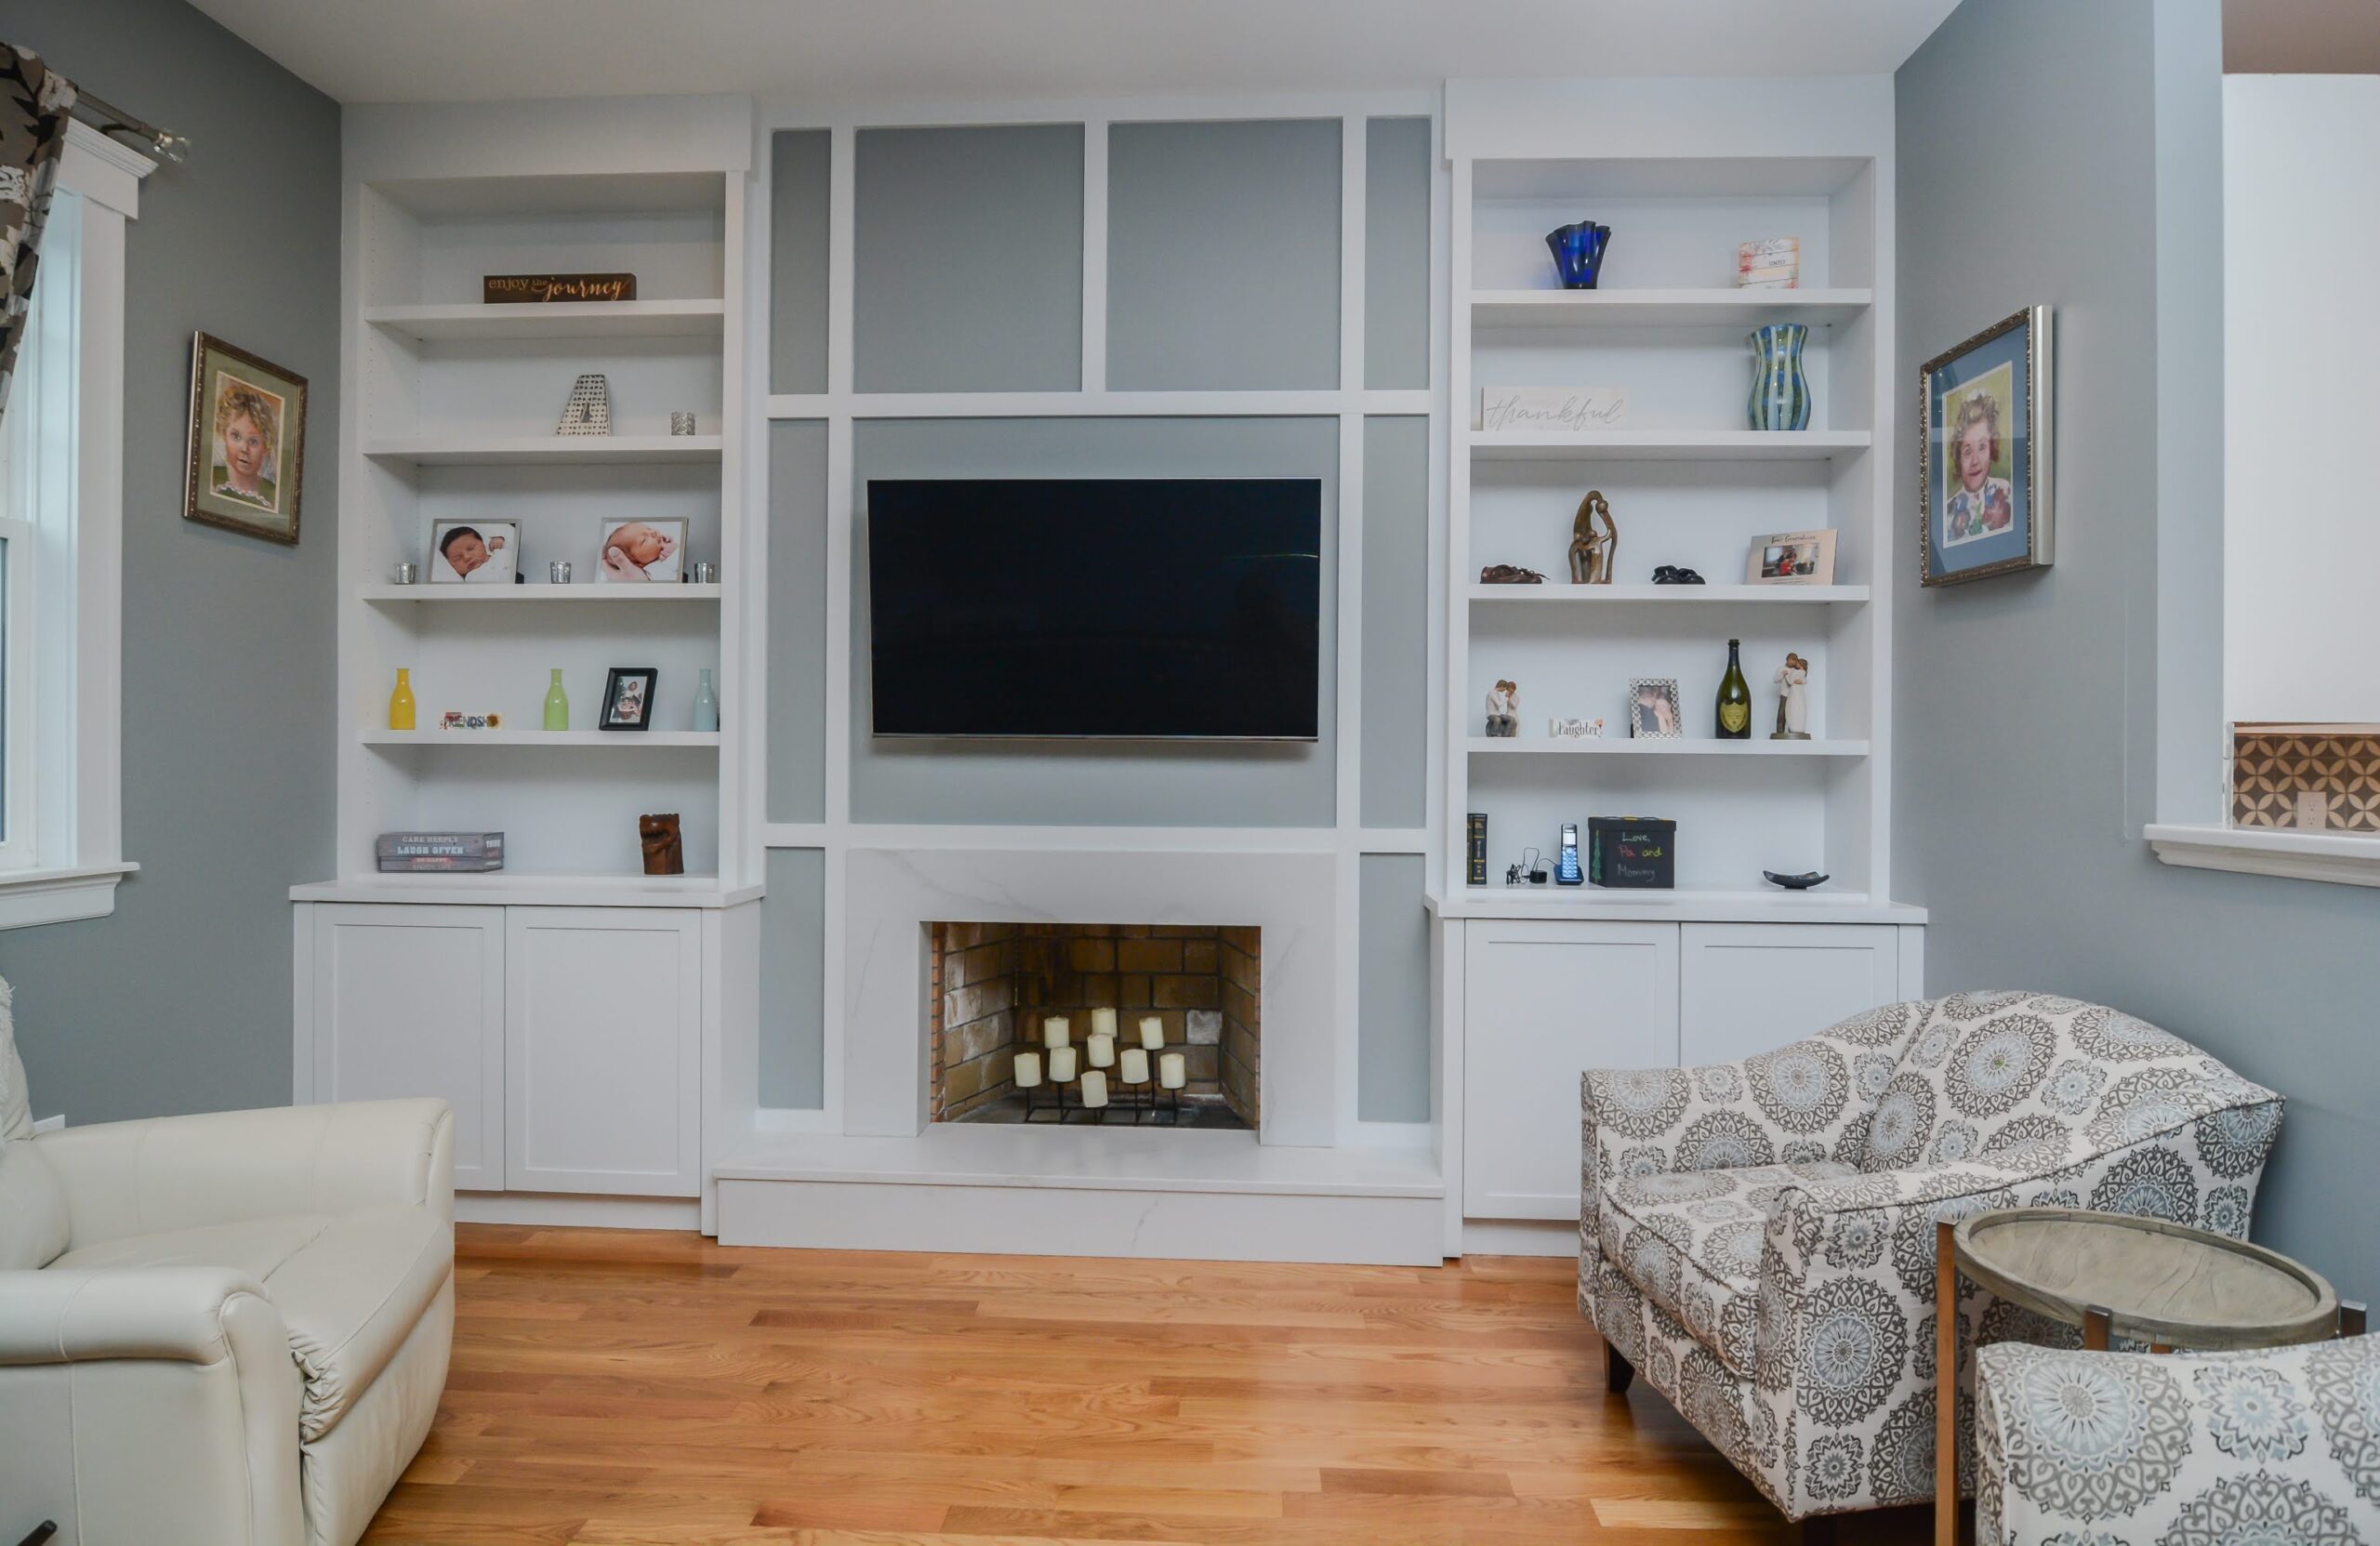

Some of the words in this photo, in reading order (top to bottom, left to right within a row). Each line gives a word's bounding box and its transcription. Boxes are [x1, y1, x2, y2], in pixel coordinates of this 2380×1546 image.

[489, 278, 528, 291] enjoy
[537, 276, 628, 303] journey
[1486, 394, 1623, 431] thankful
[1559, 721, 1598, 739] Laughter
[397, 846, 430, 854] LAUGH
[431, 846, 464, 854] OFTEN
[1642, 846, 1662, 857] and
[1618, 863, 1655, 882] Mommy
